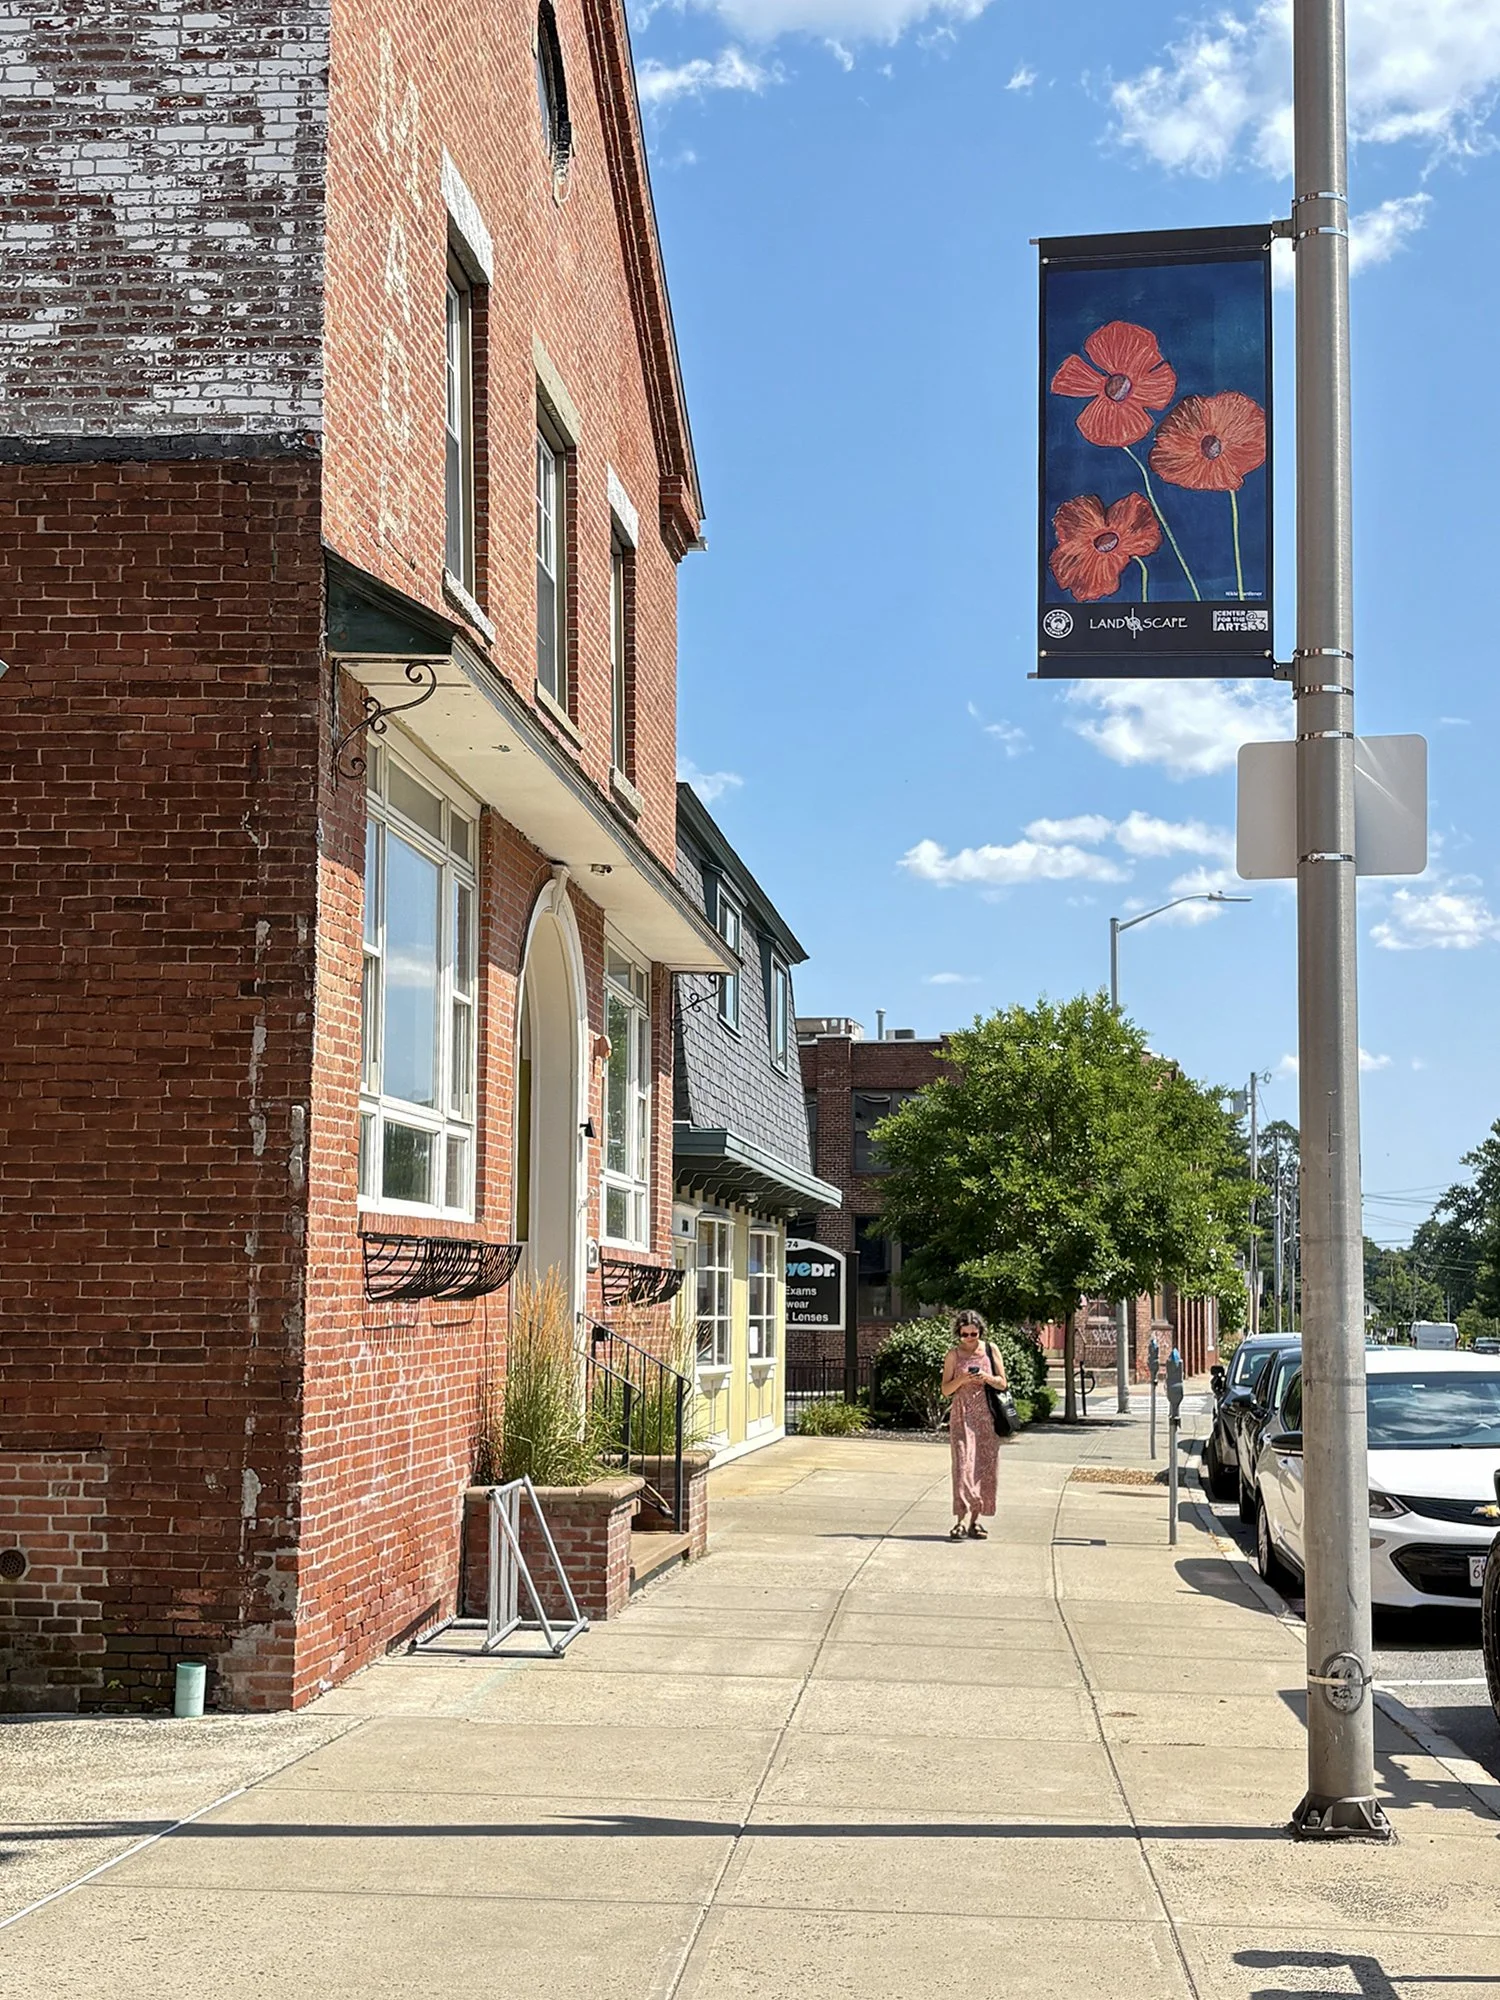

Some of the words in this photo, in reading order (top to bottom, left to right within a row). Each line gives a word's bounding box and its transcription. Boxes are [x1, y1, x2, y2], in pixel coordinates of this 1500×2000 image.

[1217, 623, 1248, 631] ARTS
[785, 1285, 817, 1296] Exams
[792, 1312, 829, 1322] Lenses
